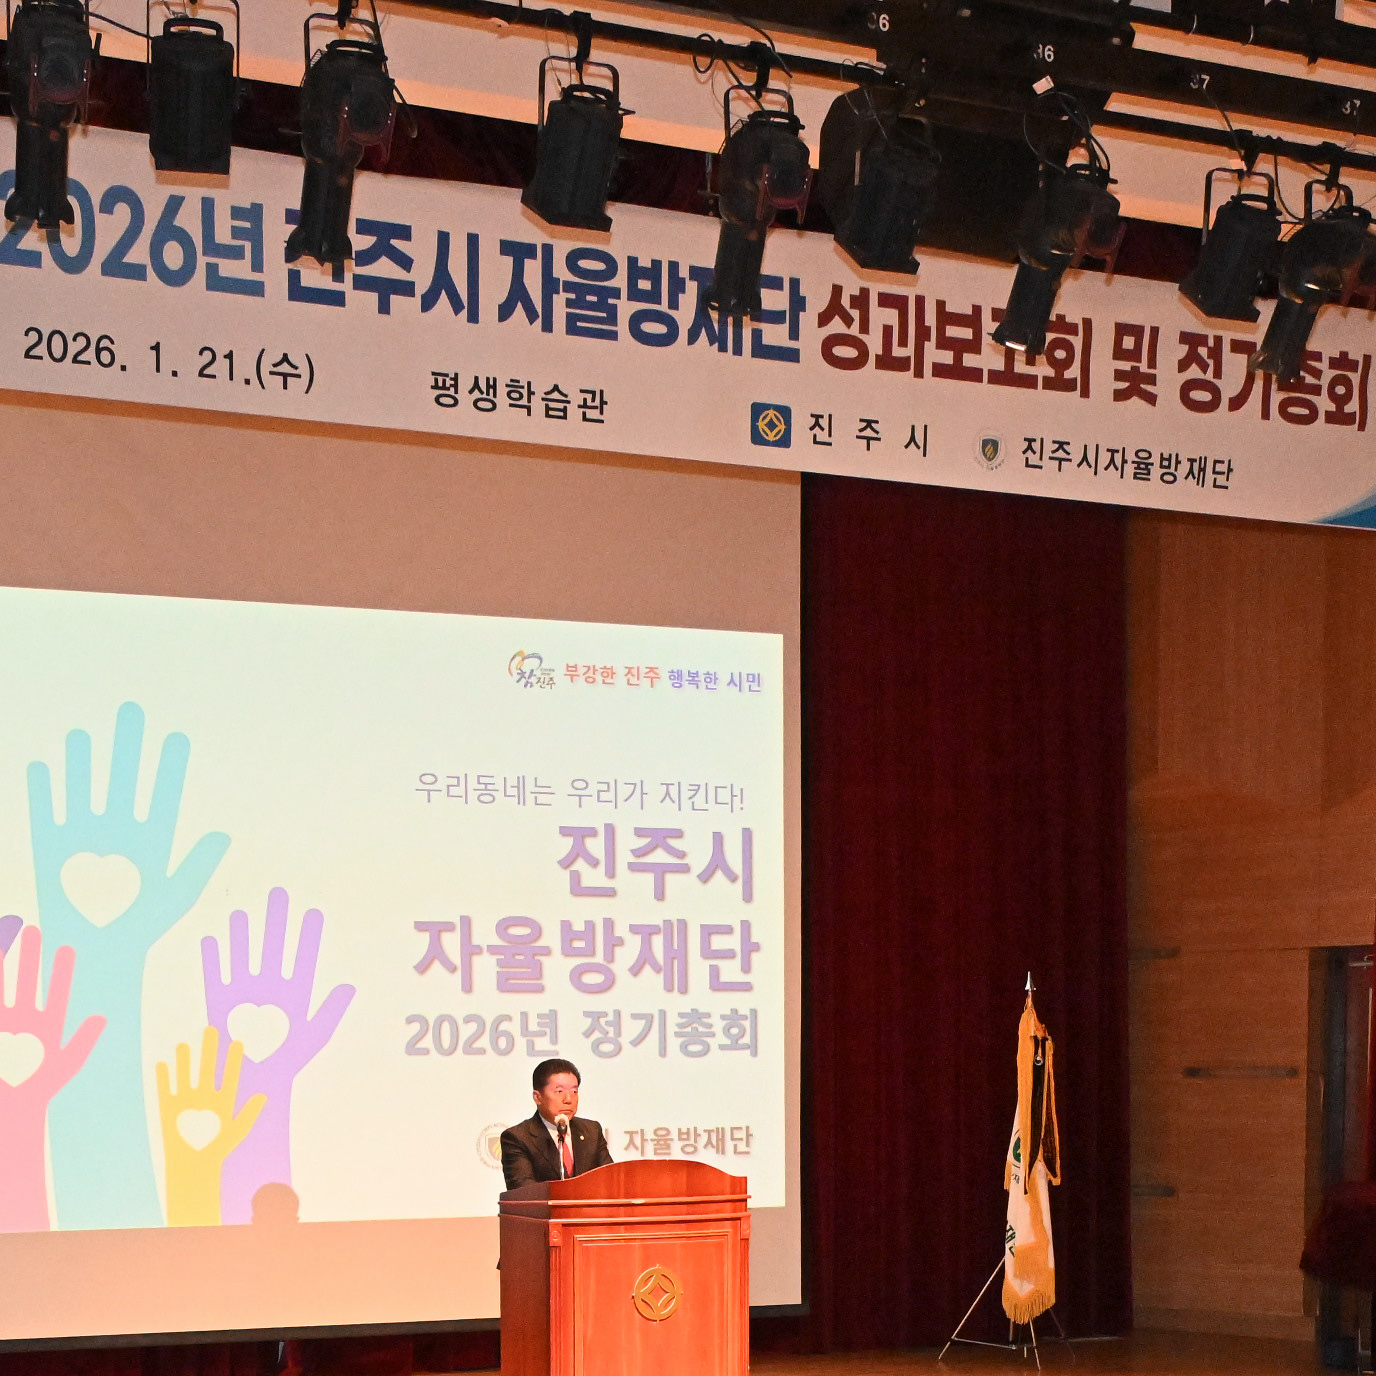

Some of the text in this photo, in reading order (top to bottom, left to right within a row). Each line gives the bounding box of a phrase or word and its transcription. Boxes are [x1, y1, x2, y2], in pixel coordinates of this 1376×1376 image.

[24, 326, 127, 372] 2026.
[149, 341, 178, 378] 1.
[1112, 321, 1160, 408] 및
[430, 371, 609, 424] 평생학습관
[1021, 436, 1234, 490] 진주시자율방재단
[563, 663, 763, 694] 부강한 진주 행복한 시민
[414, 772, 745, 814] 우리동네는 우리가 지킨다!
[556, 822, 754, 903] 진주시
[412, 915, 761, 994] 자율방재단
[404, 1007, 759, 1058] 2026년 정기총회
[623, 1125, 754, 1156] 자율방재단
